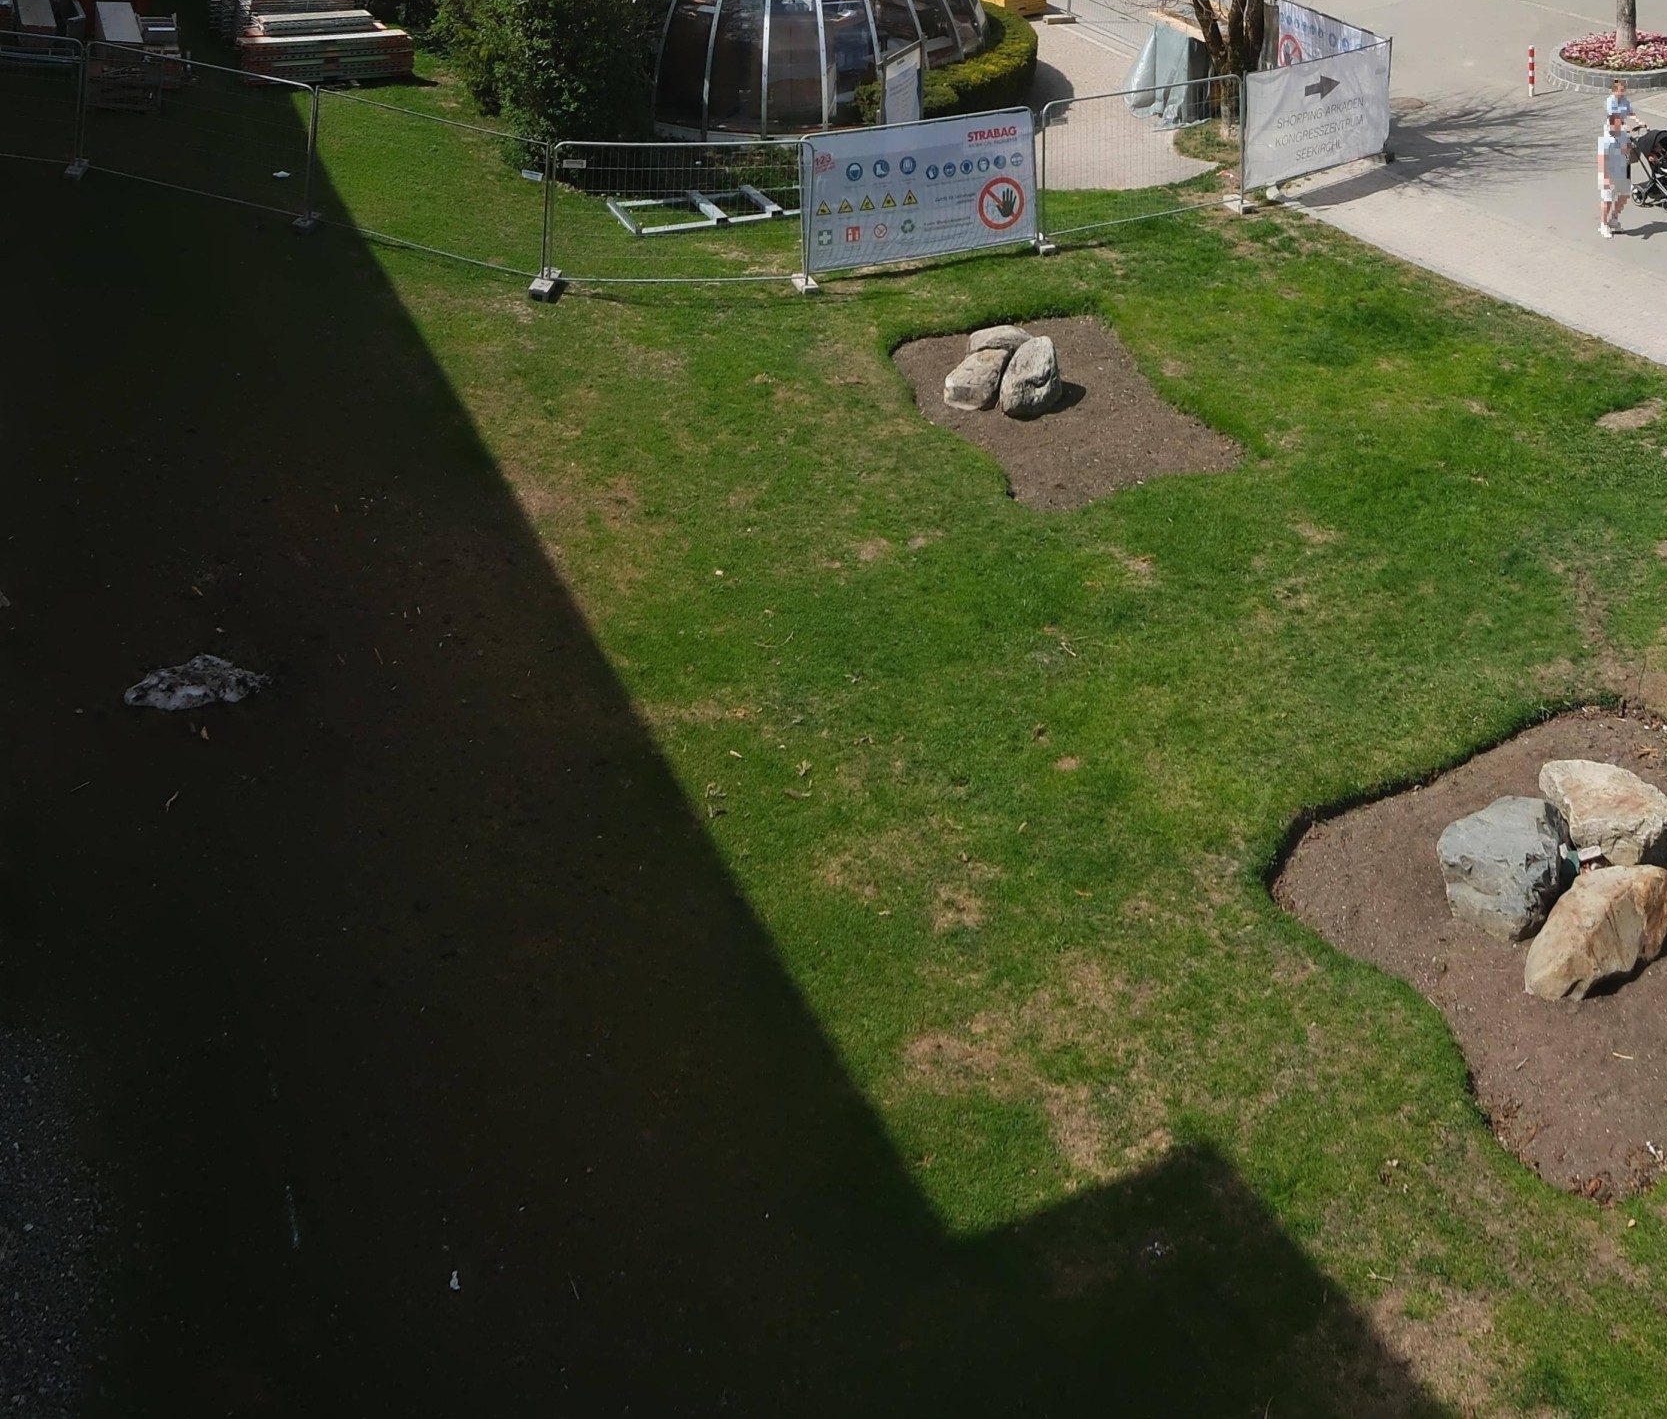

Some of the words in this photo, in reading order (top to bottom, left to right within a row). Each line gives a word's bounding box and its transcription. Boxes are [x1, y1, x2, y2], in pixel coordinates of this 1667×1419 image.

[1276, 107, 1323, 130] SHOPPING
[1324, 96, 1364, 117] ARKADEN
[967, 125, 1018, 143] STRABAG
[1274, 115, 1364, 148] KONGRESSZENTRUM
[1295, 139, 1343, 162] SEEKIRCHL
